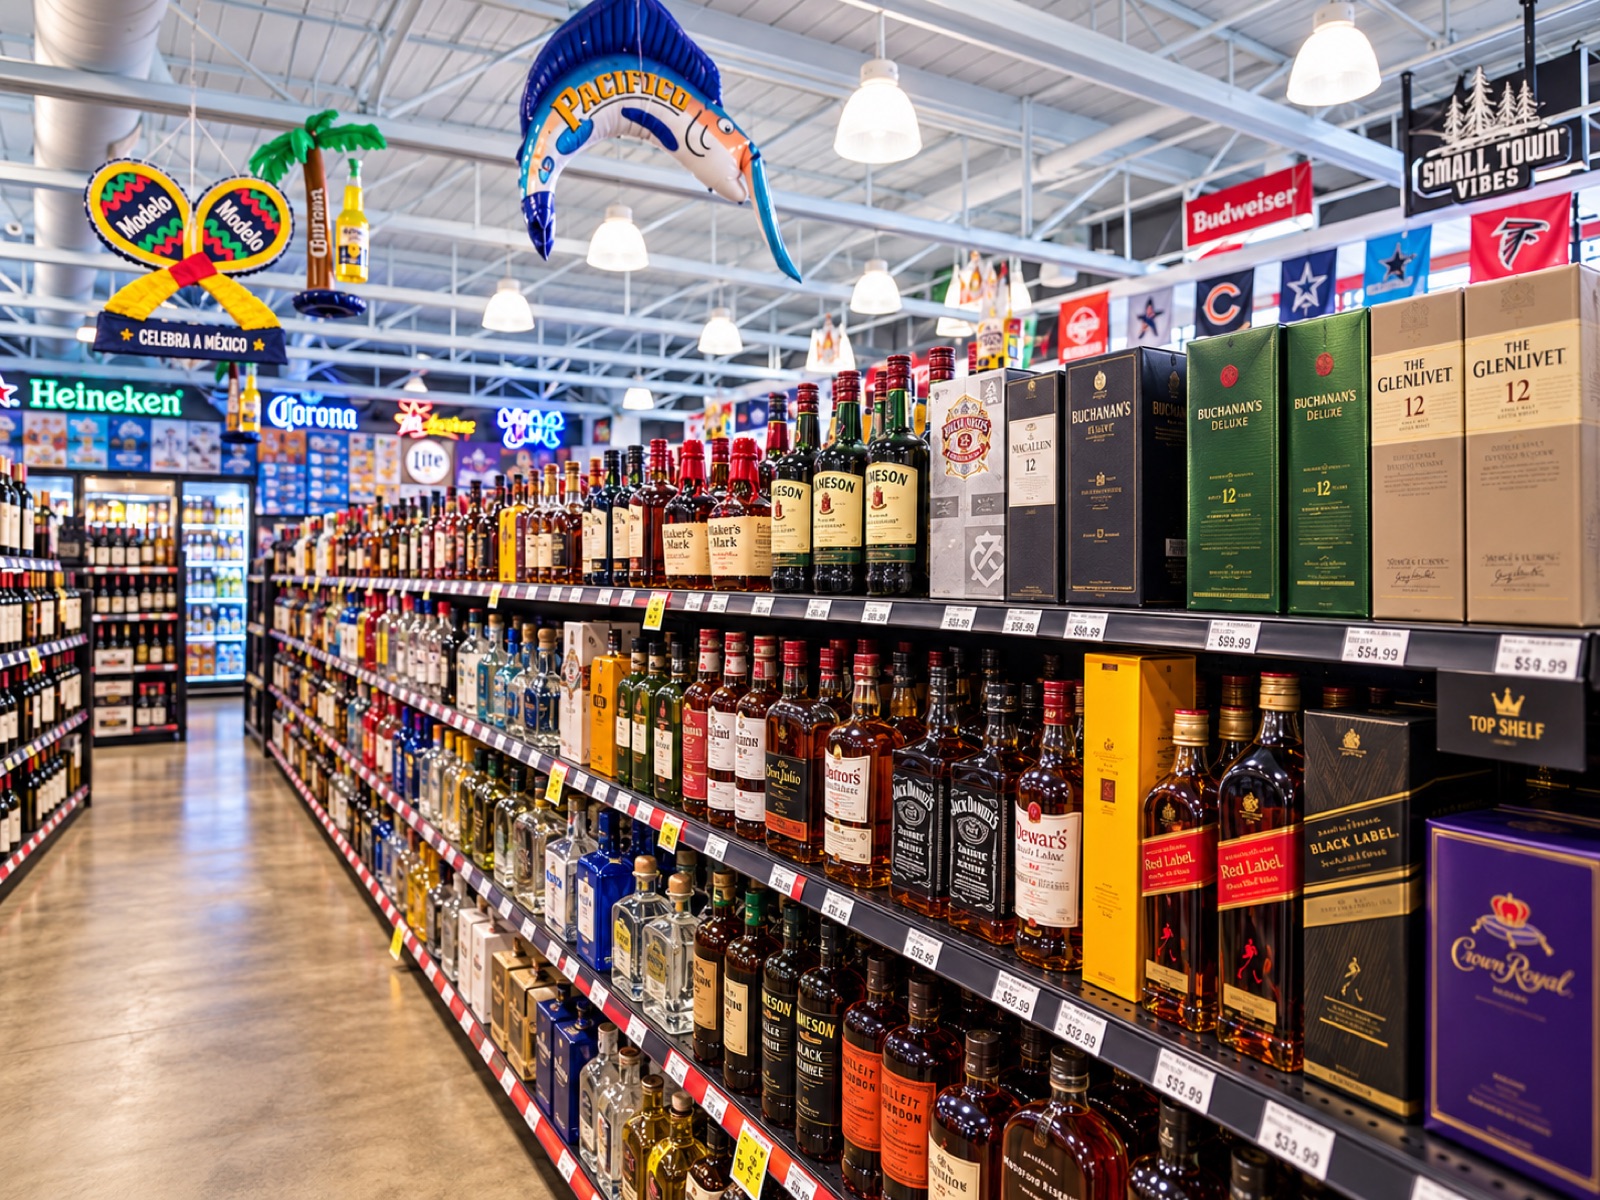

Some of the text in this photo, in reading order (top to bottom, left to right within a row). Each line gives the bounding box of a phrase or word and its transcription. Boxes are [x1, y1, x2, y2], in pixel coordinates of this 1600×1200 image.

[550, 69, 693, 133] PACIFICO
[1422, 129, 1561, 188] SMALL TOWN
[1456, 168, 1519, 199] VIBES
[115, 193, 173, 240] Modelo
[1192, 185, 1297, 235] Budweiser
[214, 198, 265, 252] Modelo
[138, 328, 248, 353] CELEBRA A MÉXICO
[1504, 339, 1530, 355] THE
[1404, 358, 1426, 372] THE
[1473, 347, 1566, 379] GLENLIVET
[1377, 366, 1453, 393] GLENLIVET
[1505, 379, 1531, 404] 12
[29, 379, 182, 417] Heineken
[1197, 400, 1263, 420] BUCHANAN'S
[1294, 389, 1356, 410] BUCHANAN'S
[1403, 395, 1425, 418] 12
[267, 394, 358, 432] Corona
[1072, 401, 1131, 424] BUCHANAN'S
[1211, 417, 1249, 431] DELUXE
[1306, 406, 1343, 421] DELUXE
[414, 451, 443, 472] Lite
[1025, 458, 1036, 472] 12
[1222, 488, 1237, 503] 12
[1317, 480, 1331, 496] 12
[1469, 715, 1545, 740] TOP SHELF
[1016, 820, 1067, 850] Dewar's
[1310, 836, 1351, 855] BLACK
[1145, 857, 1163, 871] Red
[1220, 860, 1244, 880] Red
[1451, 936, 1576, 997] Crown Royal
